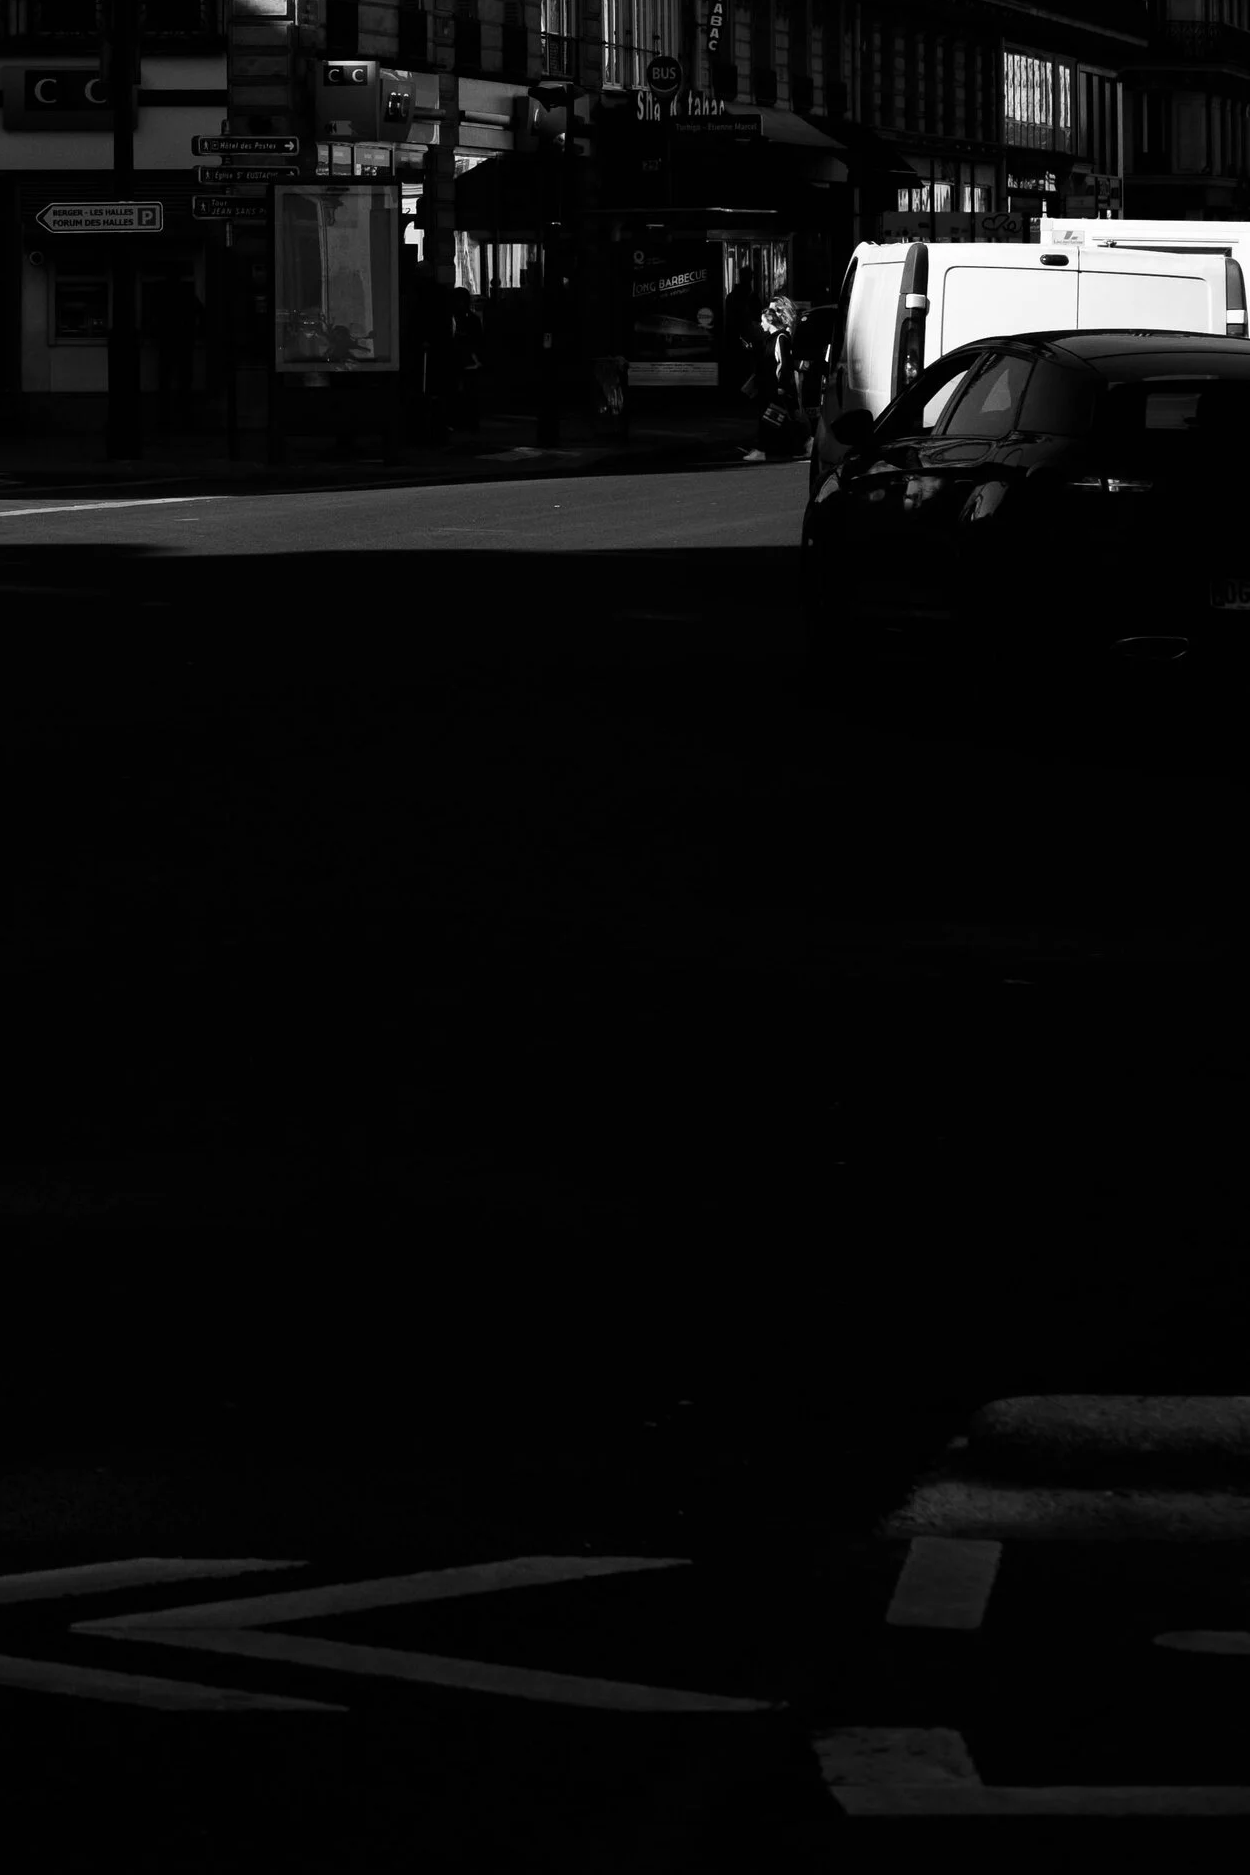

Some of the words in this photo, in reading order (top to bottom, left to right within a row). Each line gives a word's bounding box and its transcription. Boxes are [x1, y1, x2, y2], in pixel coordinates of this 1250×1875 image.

[652, 67, 677, 80] BUS
[240, 141, 252, 150] des
[254, 141, 277, 150] Postes
[52, 219, 82, 227] FORUM
[103, 218, 134, 226] HALLES
[632, 280, 656, 297] LONG
[658, 269, 707, 289] BARBECUE
